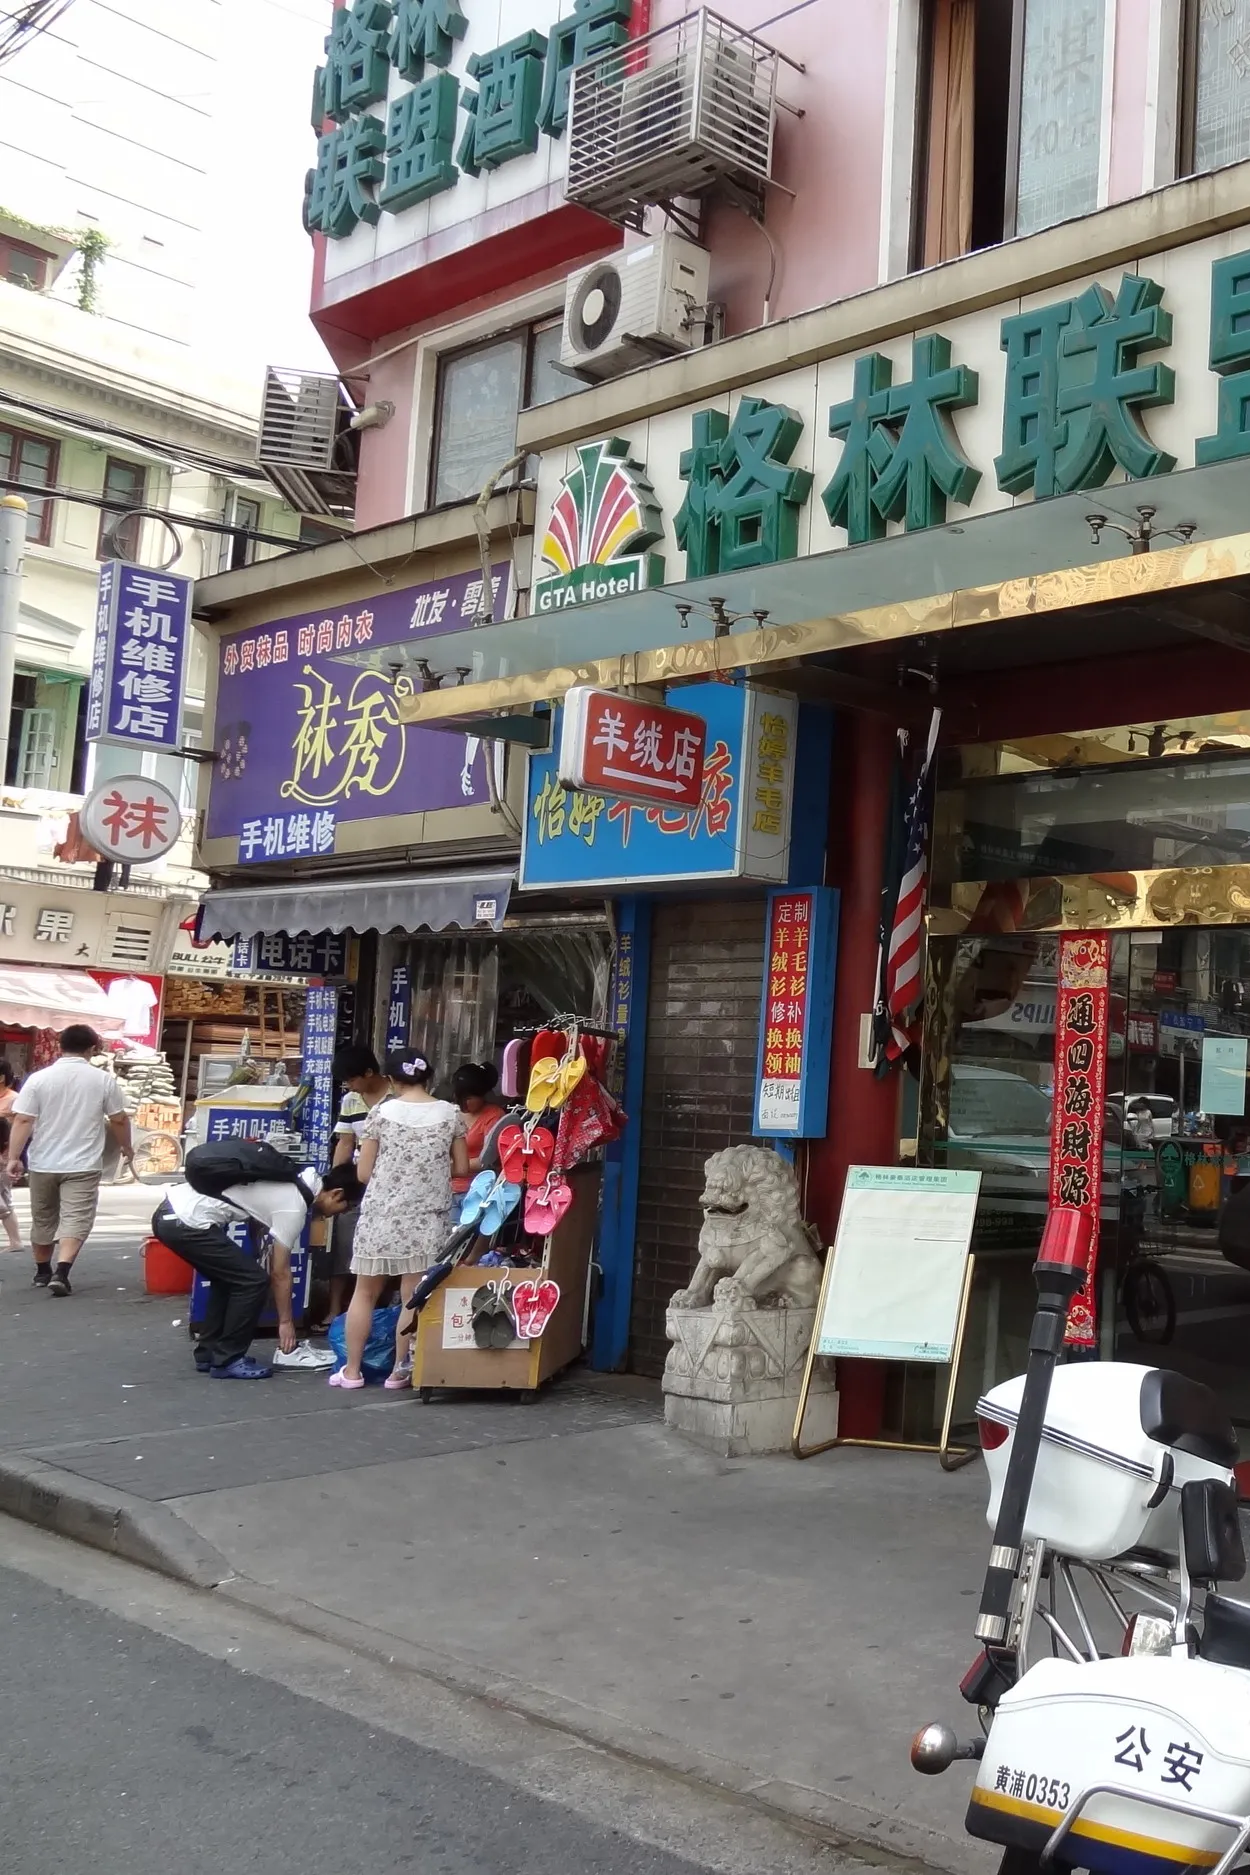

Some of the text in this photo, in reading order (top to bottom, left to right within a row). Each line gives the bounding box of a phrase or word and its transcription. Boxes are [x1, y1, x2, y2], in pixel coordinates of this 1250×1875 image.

[540, 572, 635, 610] GTA Hotel
[88, 571, 112, 730] 手机维修店
[114, 574, 180, 738] 手机维修店
[223, 609, 375, 676] 外贸袜品 时尚内衣
[280, 664, 415, 806] 袜秀
[592, 708, 702, 780] 羊绒店
[102, 790, 170, 850] 袜
[240, 811, 336, 860] 手机维修
[777, 900, 808, 925] 定制
[172, 952, 226, 964] BULL 公牛
[261, 935, 342, 972] 电话卡
[308, 991, 336, 1010] 手机卡号
[770, 1001, 802, 1023] 修补
[1058, 993, 1097, 1210] 通四海財源
[212, 1118, 287, 1142] 手机贴膜
[1113, 1725, 1205, 1793] 公安
[994, 1764, 1071, 1811] 黄浦0353
